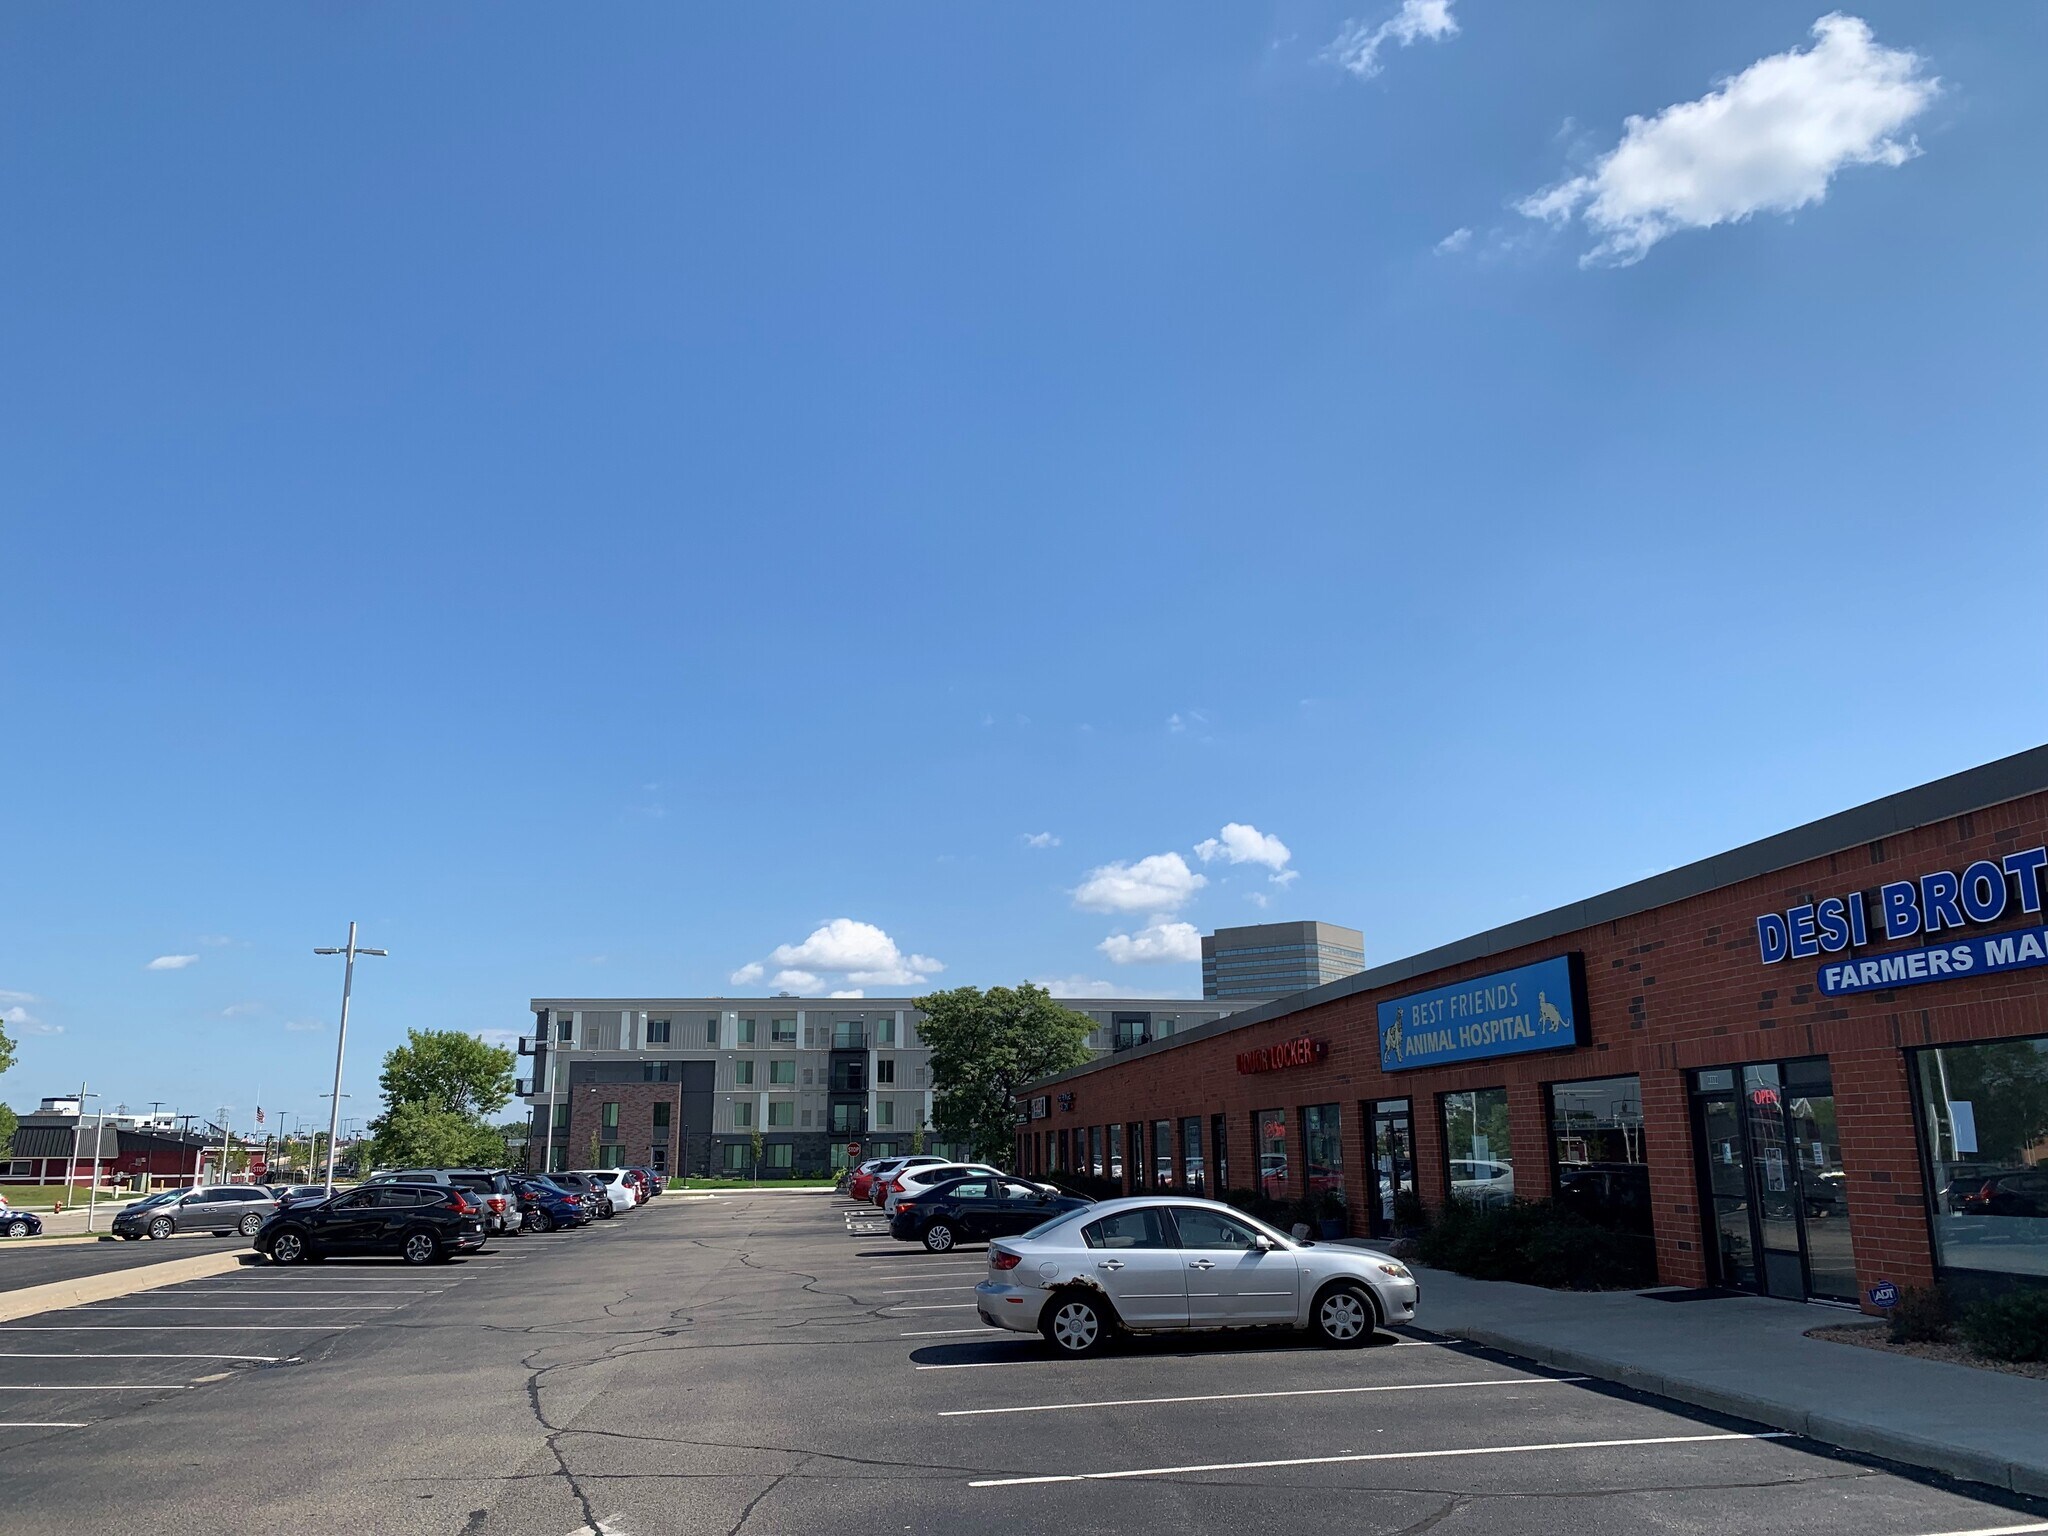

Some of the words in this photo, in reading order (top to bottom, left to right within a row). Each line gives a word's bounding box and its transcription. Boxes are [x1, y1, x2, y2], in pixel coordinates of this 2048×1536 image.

[1756, 891, 1867, 965] DESI
[1881, 846, 2047, 940] BROT
[1825, 945, 1974, 991] FARMERS
[1984, 931, 2048, 966] MA
[1412, 1000, 1443, 1026] BEST
[1450, 982, 1518, 1019] FRIENDS
[1236, 1049, 1268, 1074] IQUOR
[1271, 1038, 1312, 1069] LOCKER
[1405, 1029, 1457, 1057] ANIMAL
[1459, 1013, 1536, 1048] HOSPITAL
[1754, 1088, 1778, 1104] OPEN
[1874, 1288, 1894, 1301] ADT
